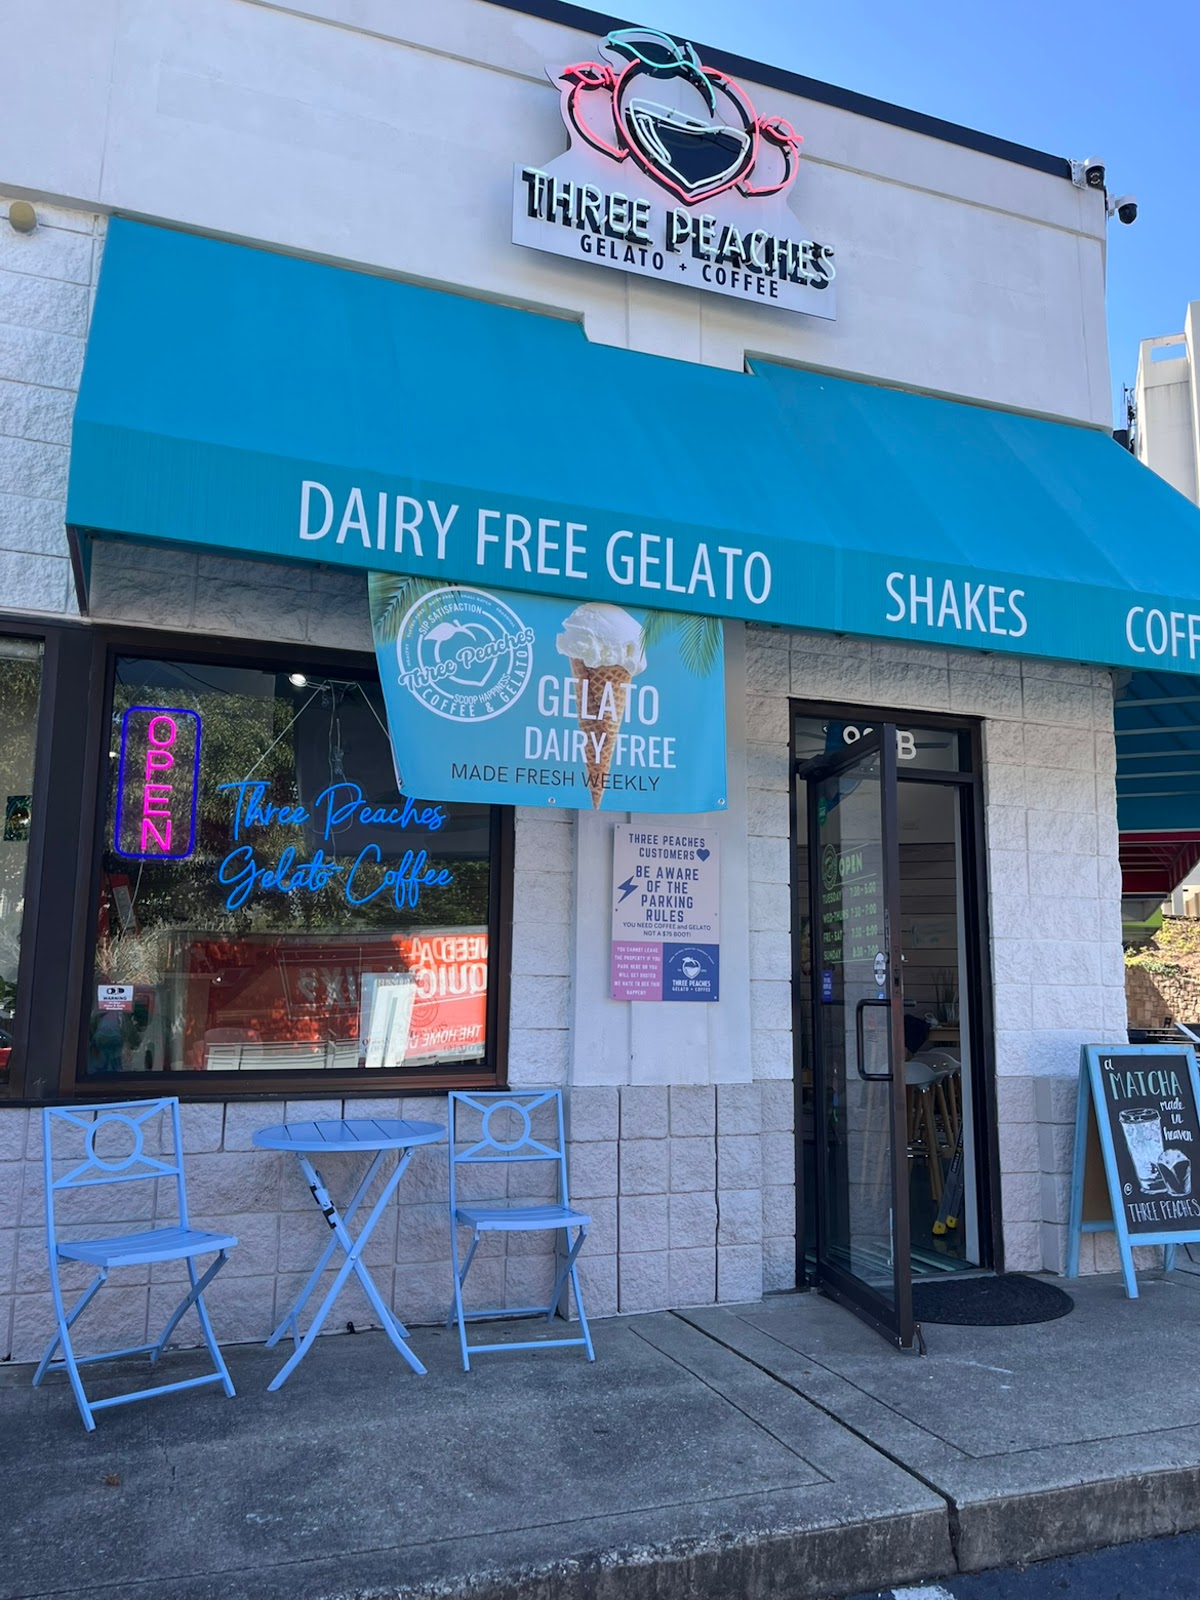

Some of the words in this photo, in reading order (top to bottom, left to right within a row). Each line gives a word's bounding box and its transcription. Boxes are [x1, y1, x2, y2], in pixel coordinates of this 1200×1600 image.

[522, 167, 653, 245] THREE
[666, 206, 836, 289] PEACHES
[580, 234, 663, 271] GELATO
[702, 264, 779, 298] COFFEE
[299, 480, 459, 560] DAIRY
[477, 508, 588, 579] FREE
[606, 529, 772, 605] GELATO
[886, 572, 1028, 637] SHAKES
[418, 621, 430, 636] SIP
[428, 603, 482, 623] SATISFACTION
[398, 658, 457, 693] Three
[456, 627, 535, 669] Peaches
[422, 688, 476, 717] COFFEE
[486, 702, 495, 713] &
[500, 650, 528, 702] GELATO
[454, 693, 478, 704] SCOOP
[478, 673, 511, 702] HAPPINESS
[537, 674, 659, 725] GELATO
[524, 727, 606, 764] DAIRY
[616, 735, 676, 768] FREE
[141, 716, 176, 850] OPEN
[451, 763, 508, 783] MADE
[516, 768, 575, 787] FRESH
[581, 772, 660, 792] WEEKLY
[219, 781, 309, 840] Three
[316, 783, 447, 840] Peaches
[629, 833, 658, 845] THREE
[663, 836, 705, 848] PEACHES
[639, 847, 694, 860] CUSTOMERS
[218, 846, 344, 910] Gelato
[346, 844, 453, 908] Coffee
[636, 866, 650, 878] BE
[656, 866, 699, 880] AWARE
[839, 852, 863, 877] OPEN
[641, 894, 693, 908] PARKING
[647, 880, 661, 892] OF
[667, 881, 688, 894] THE
[822, 891, 841, 905] TUESDAY
[646, 909, 684, 922] RULES
[824, 949, 841, 961] SUNDAY
[1104, 1058, 1114, 1071] a
[1109, 1070, 1182, 1100] MATCHA
[1160, 1100, 1185, 1111] made
[1171, 1113, 1184, 1124] in
[1163, 1127, 1193, 1142] heaven
[1128, 1202, 1160, 1223] THREE
[1160, 1198, 1200, 1220] PEACHES
